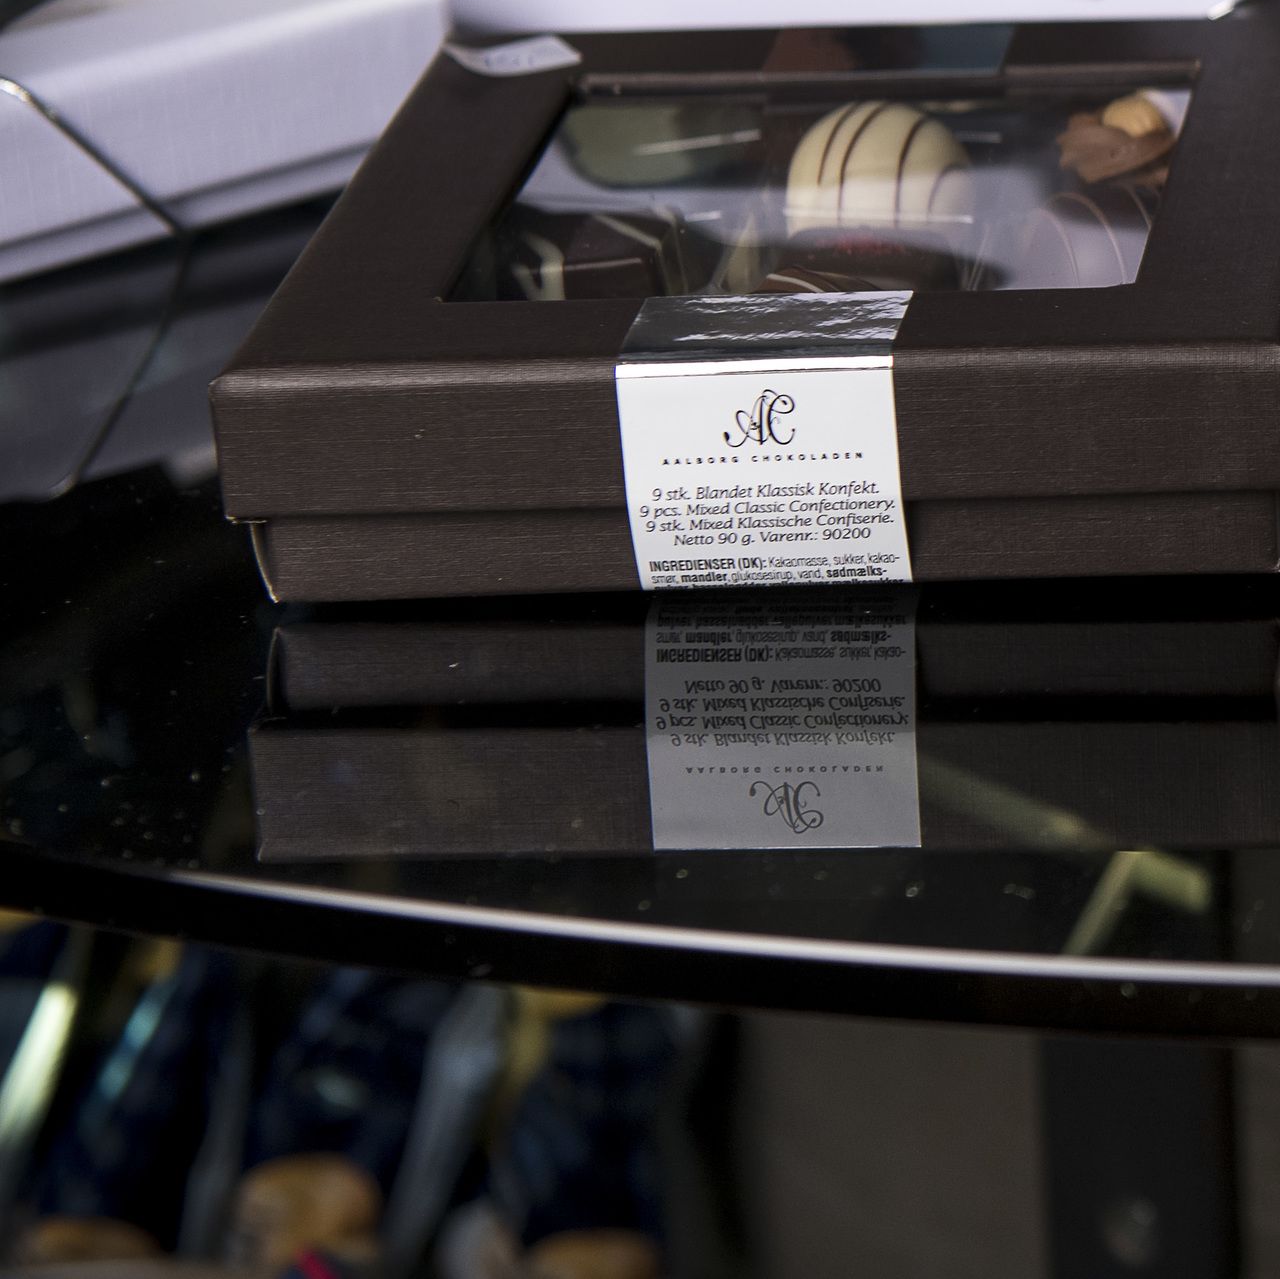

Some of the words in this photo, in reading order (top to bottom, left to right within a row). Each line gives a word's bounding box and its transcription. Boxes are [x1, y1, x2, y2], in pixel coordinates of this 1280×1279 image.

[662, 455, 740, 466] AALBORG
[750, 451, 865, 463] CHOKOLADEN
[652, 488, 662, 501] 9
[665, 487, 691, 501] stk.
[696, 485, 752, 500] Blandet
[756, 482, 815, 497] Klassisk
[818, 480, 880, 499] Konfekt.
[639, 506, 649, 518] 9
[654, 506, 682, 519] pcs.
[686, 503, 730, 516] Mixed
[735, 501, 786, 514] Classic
[789, 498, 896, 514] Confectionery.
[645, 521, 656, 532] 9
[659, 519, 685, 532] stk.
[689, 518, 734, 531] Mixed
[738, 515, 813, 529] Klassische
[816, 513, 895, 529] Confiserie.
[674, 533, 714, 546] Netto
[718, 531, 738, 545] 90
[741, 533, 756, 547] g.
[760, 529, 818, 543] Varenr.:
[822, 527, 872, 541] 90200
[649, 559, 735, 572] INGREDIENSER
[738, 556, 767, 571] (DK):
[768, 555, 832, 568] Kakaomasse,
[833, 551, 867, 566] sukker,
[867, 551, 901, 564] kakao-
[681, 571, 731, 583] mandler,
[826, 565, 888, 578] sødmælks-
